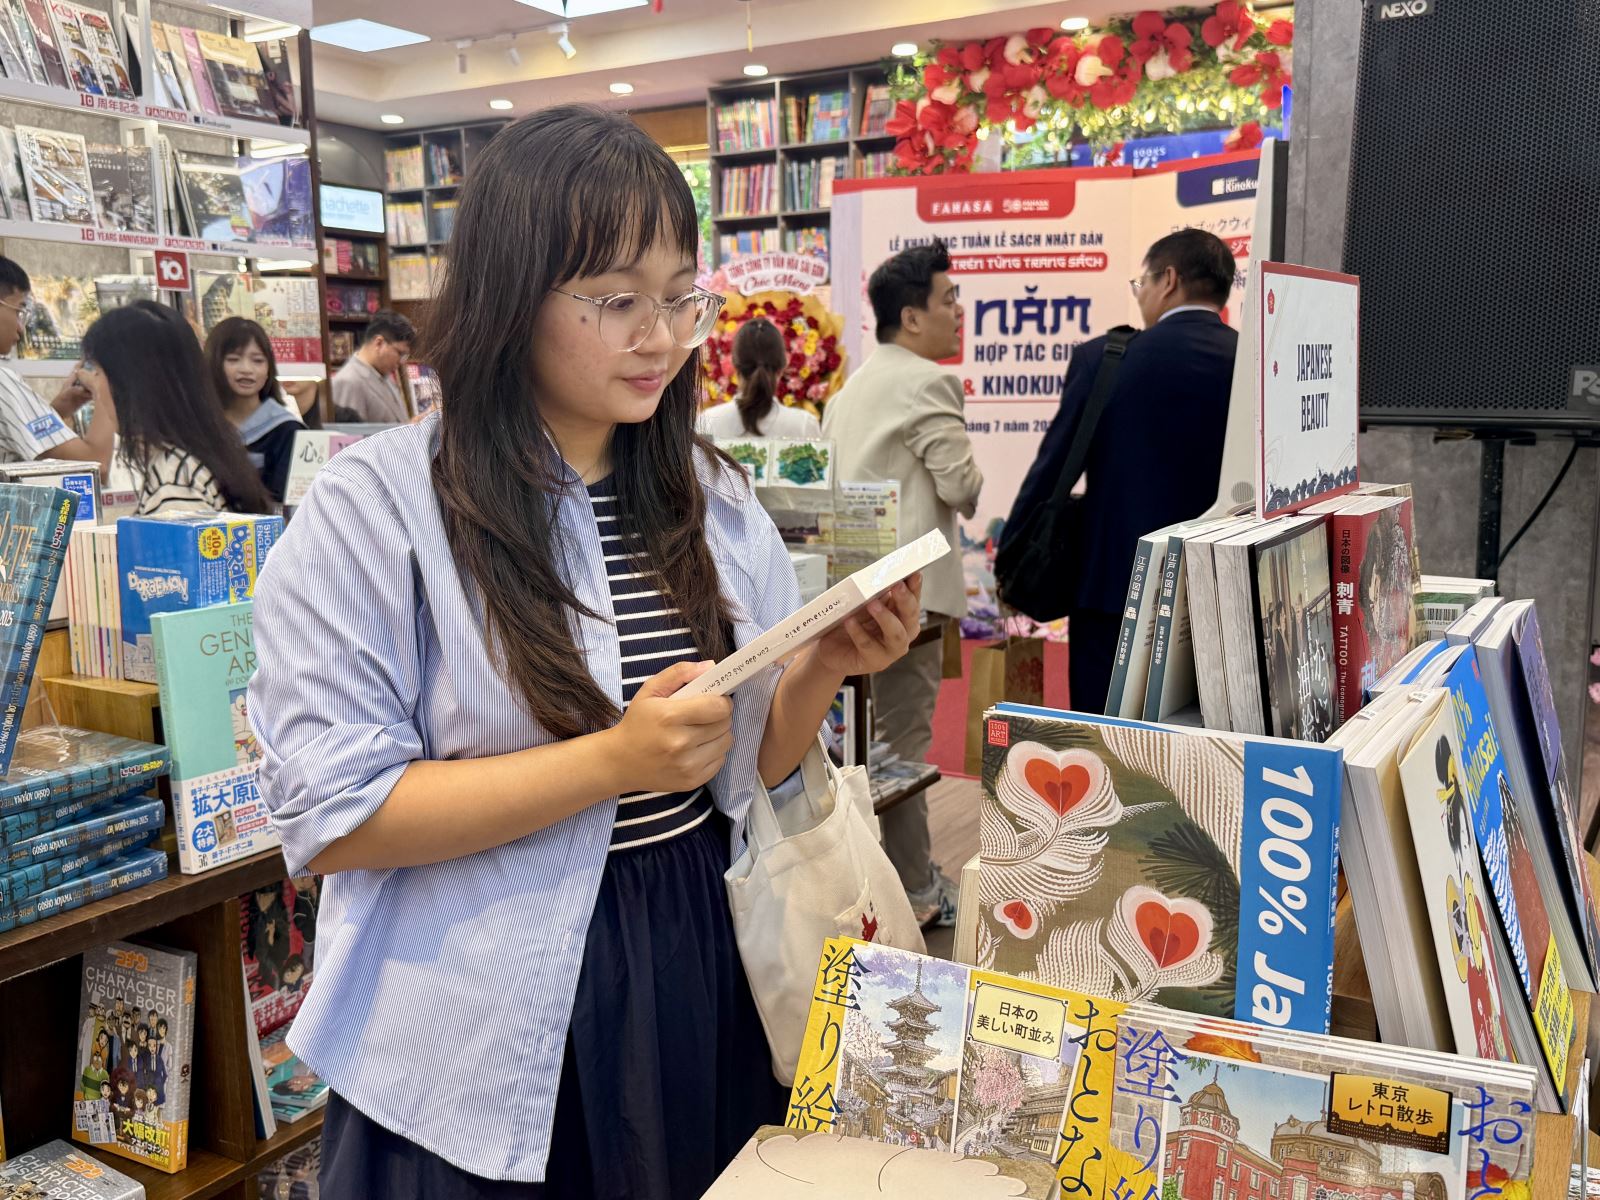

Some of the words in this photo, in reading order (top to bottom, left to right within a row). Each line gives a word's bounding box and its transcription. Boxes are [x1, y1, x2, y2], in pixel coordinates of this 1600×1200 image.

[1380, 1, 1428, 19] NEXO
[931, 200, 993, 216] FAHASA
[81, 228, 95, 241] 10
[97, 231, 118, 243] YEARS
[159, 259, 184, 281] 10
[1014, 341, 1046, 362] TÁC
[1296, 343, 1333, 382] JAPANESE
[1300, 391, 1330, 432] BEAUTY
[994, 420, 1001, 432] 7
[1335, 581, 1355, 616] 刺青
[231, 612, 253, 627] THE
[1257, 765, 1314, 936] 100%
[85, 966, 176, 1003] CHARACTER
[86, 981, 132, 1005] VISUAL
[136, 995, 175, 1018] BOOK
[998, 1000, 1039, 1023] 日本の
[788, 943, 873, 1132] 塗り絵
[976, 1013, 1056, 1046] 美しい町並み
[1056, 999, 1117, 1197] おとな
[1371, 1081, 1410, 1104] 東京
[1348, 1098, 1434, 1125] レトロ散歩
